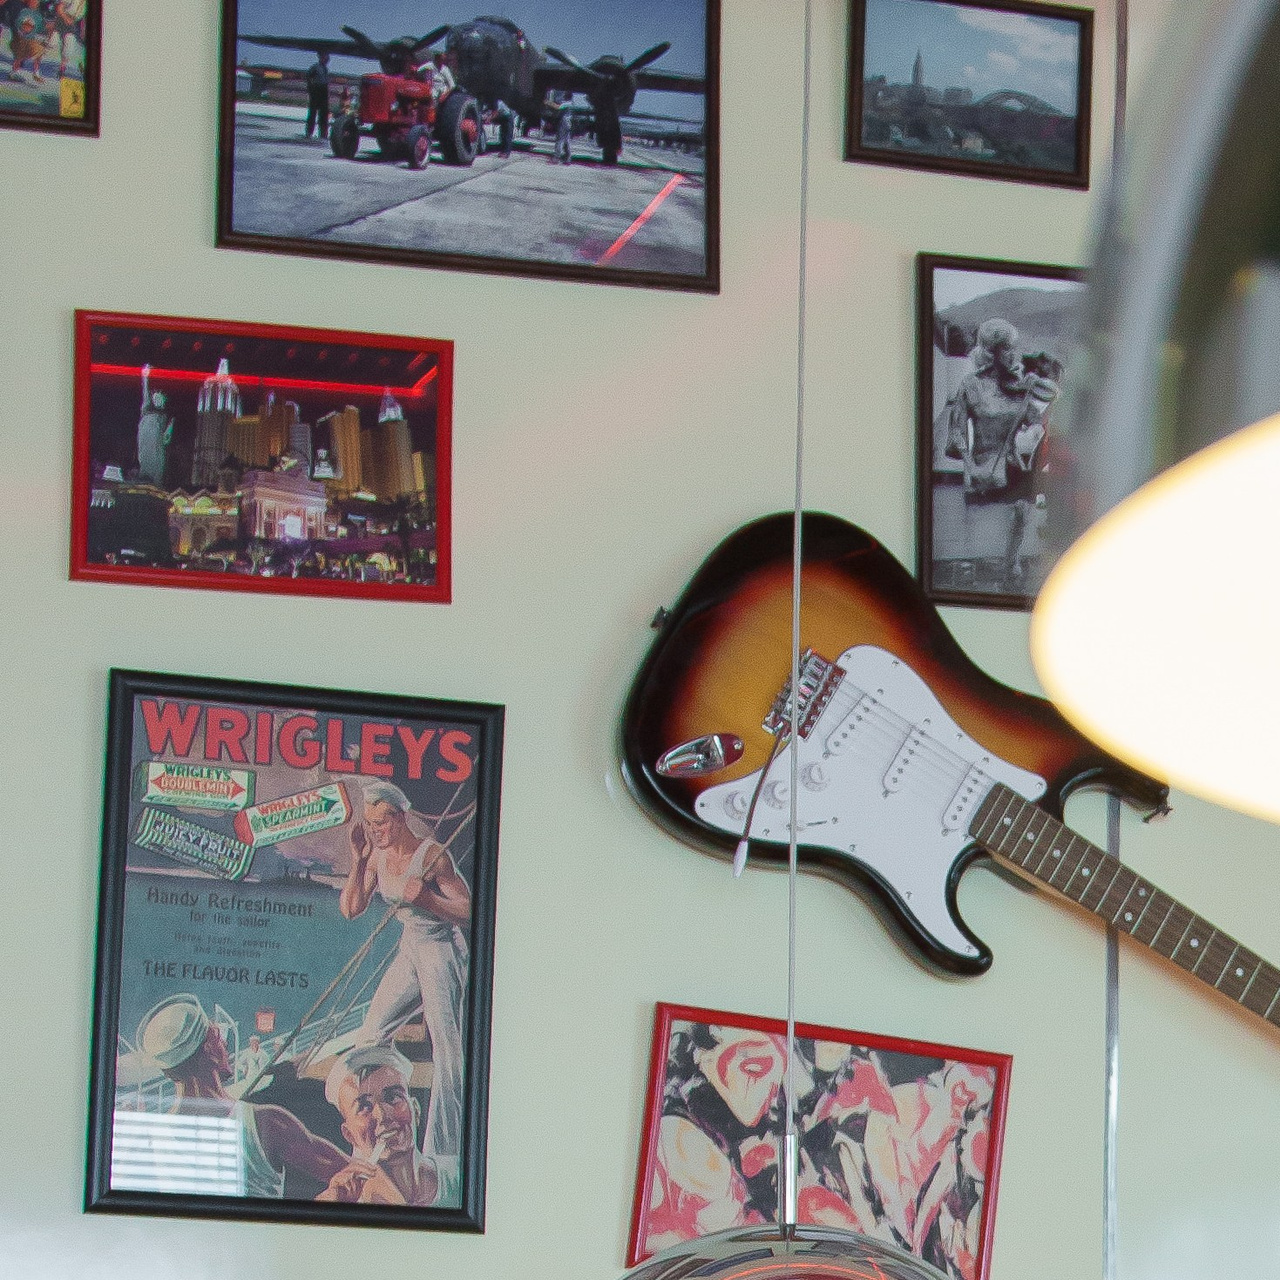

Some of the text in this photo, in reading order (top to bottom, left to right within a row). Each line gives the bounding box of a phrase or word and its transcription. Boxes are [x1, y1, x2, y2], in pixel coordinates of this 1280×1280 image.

[146, 886, 316, 918] Handy Refreshment
[143, 960, 309, 988] THE FLAVOR LASTS
